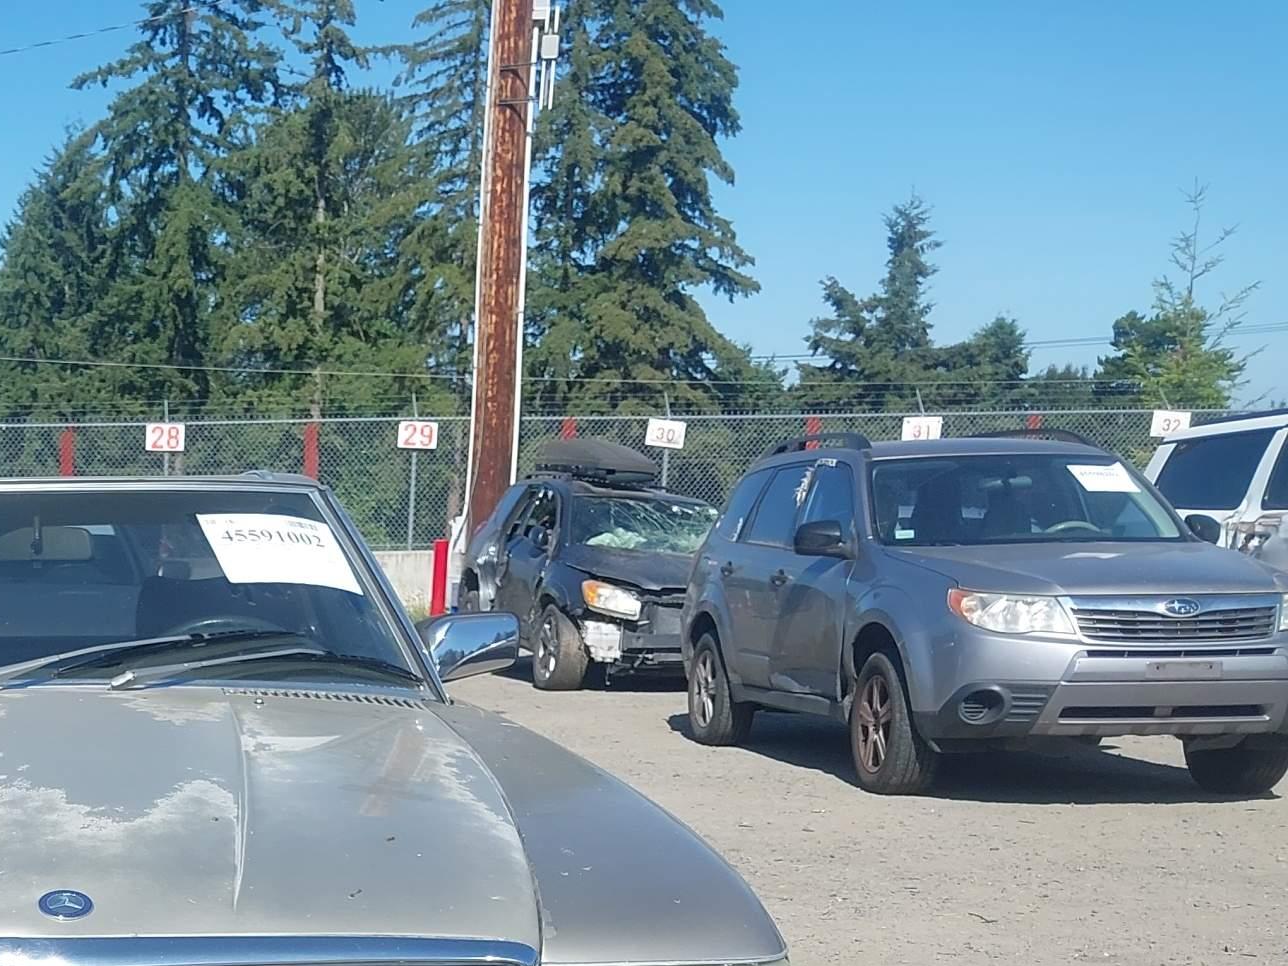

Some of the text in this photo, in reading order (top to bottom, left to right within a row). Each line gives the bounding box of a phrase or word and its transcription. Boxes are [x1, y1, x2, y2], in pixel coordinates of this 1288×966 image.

[151, 426, 179, 449] 28
[404, 423, 433, 447] 29
[656, 427, 676, 442] 30
[913, 424, 930, 440] 31
[221, 529, 325, 548] 45591002
